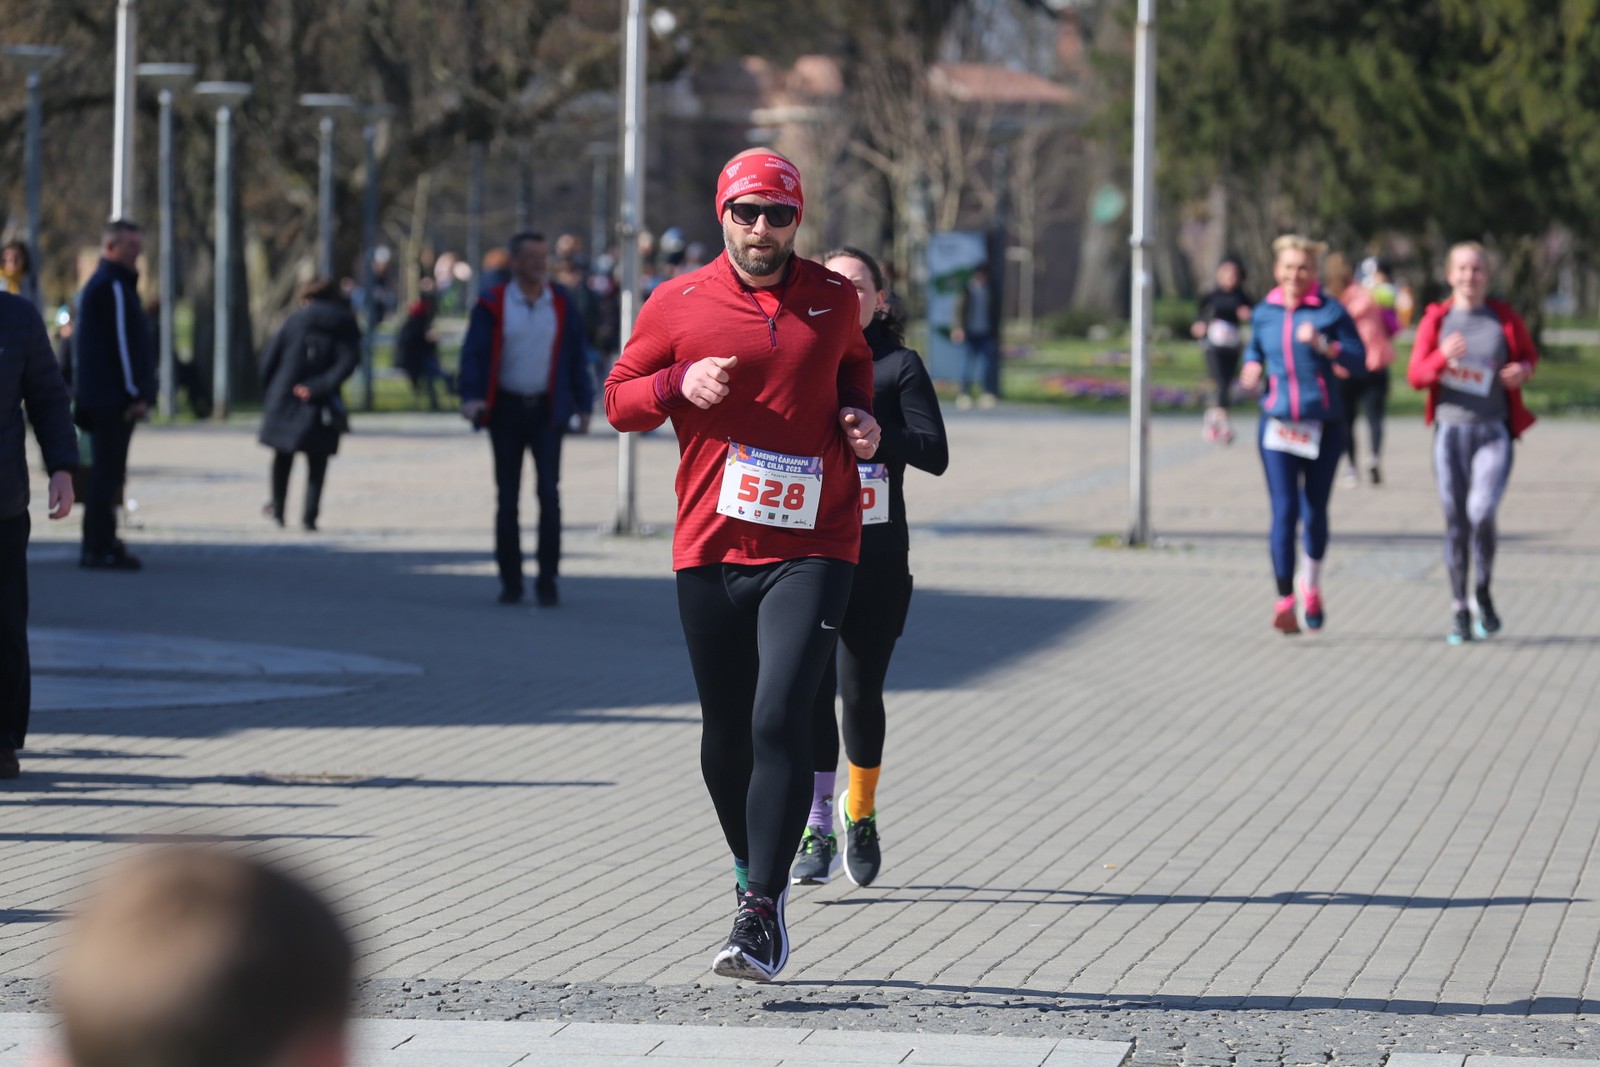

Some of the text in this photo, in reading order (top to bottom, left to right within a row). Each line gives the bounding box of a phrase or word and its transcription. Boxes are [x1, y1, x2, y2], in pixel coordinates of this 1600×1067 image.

[756, 459, 766, 468] DO
[767, 461, 784, 471] CILJA
[737, 473, 806, 511] 528
[861, 487, 875, 509] 0
